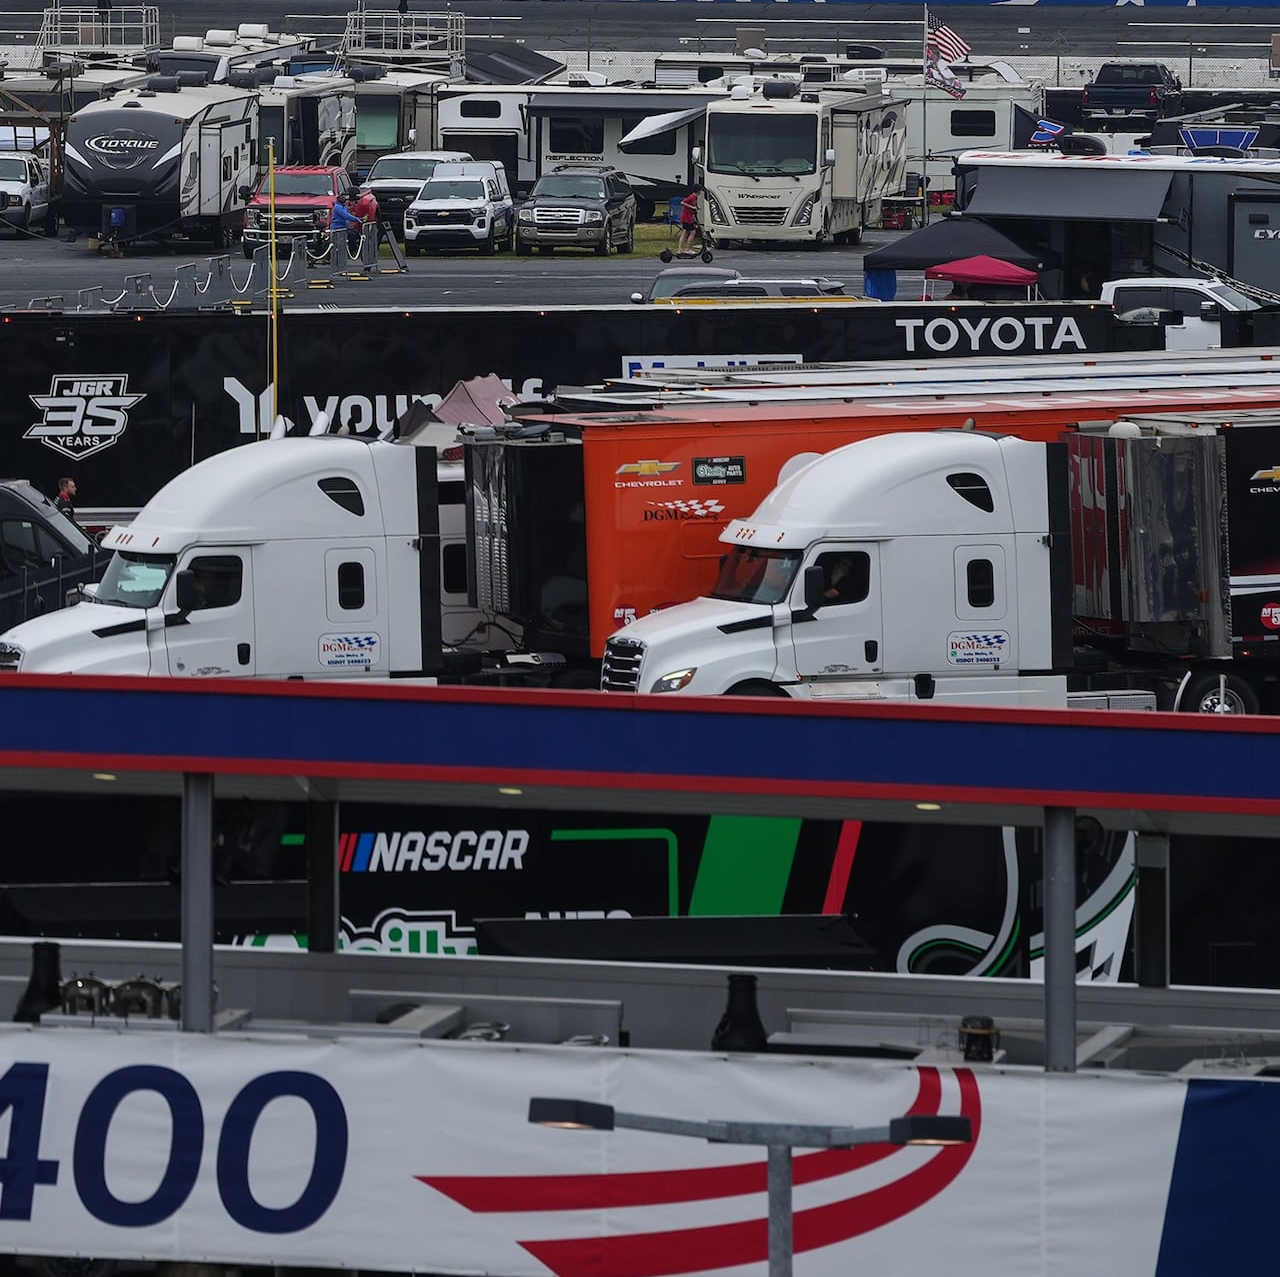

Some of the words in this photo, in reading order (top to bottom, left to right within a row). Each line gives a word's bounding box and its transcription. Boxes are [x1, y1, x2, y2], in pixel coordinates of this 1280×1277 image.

[100, 140, 159, 149] TORQUE
[896, 316, 1086, 352] TOYOTA
[63, 381, 114, 396] JGR
[29, 397, 139, 435] 35
[57, 436, 100, 446] YEARS
[614, 480, 683, 488] CHEVROLET
[644, 509, 678, 521] DGM
[323, 643, 346, 652] DGM
[951, 641, 975, 650] DGM
[369, 830, 530, 872] NASCAR
